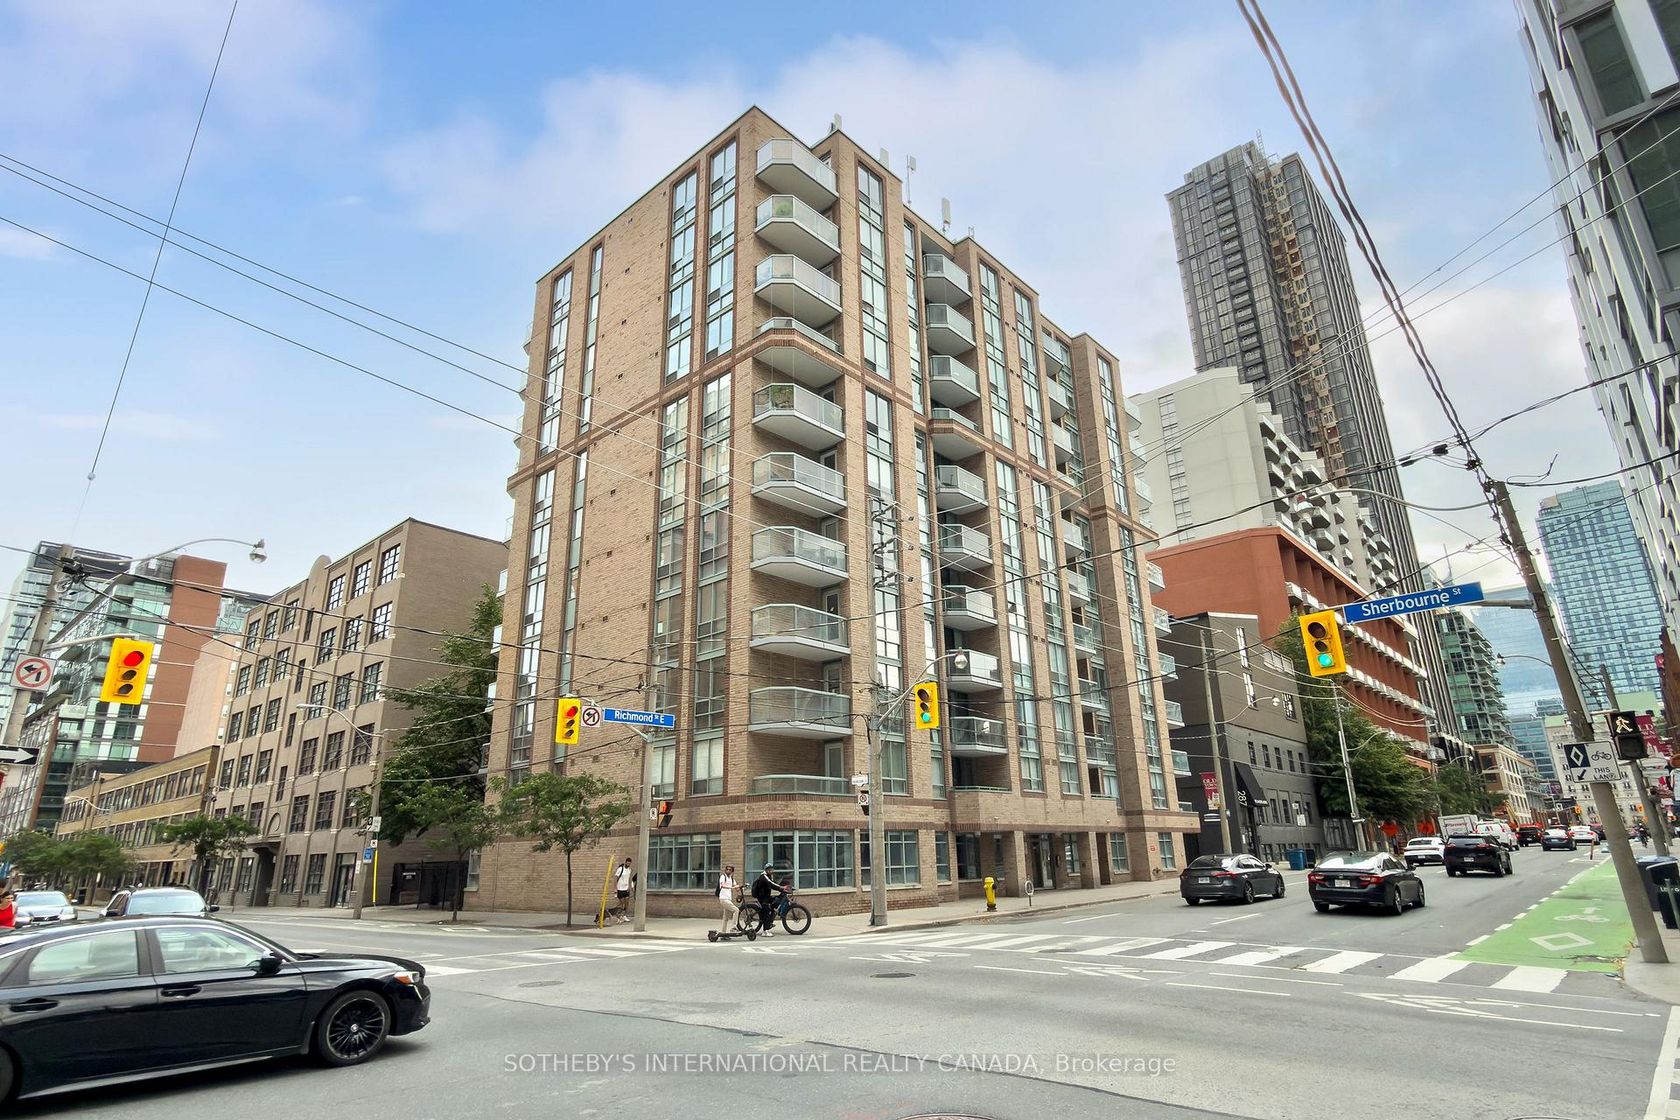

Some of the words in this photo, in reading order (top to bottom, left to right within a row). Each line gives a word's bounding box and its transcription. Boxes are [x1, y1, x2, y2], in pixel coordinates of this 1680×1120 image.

[1361, 592, 1450, 616] Sherbourne
[1452, 587, 1461, 595] St
[614, 710, 653, 723] Richmond
[660, 715, 665, 724] E
[1237, 790, 1248, 806] 287
